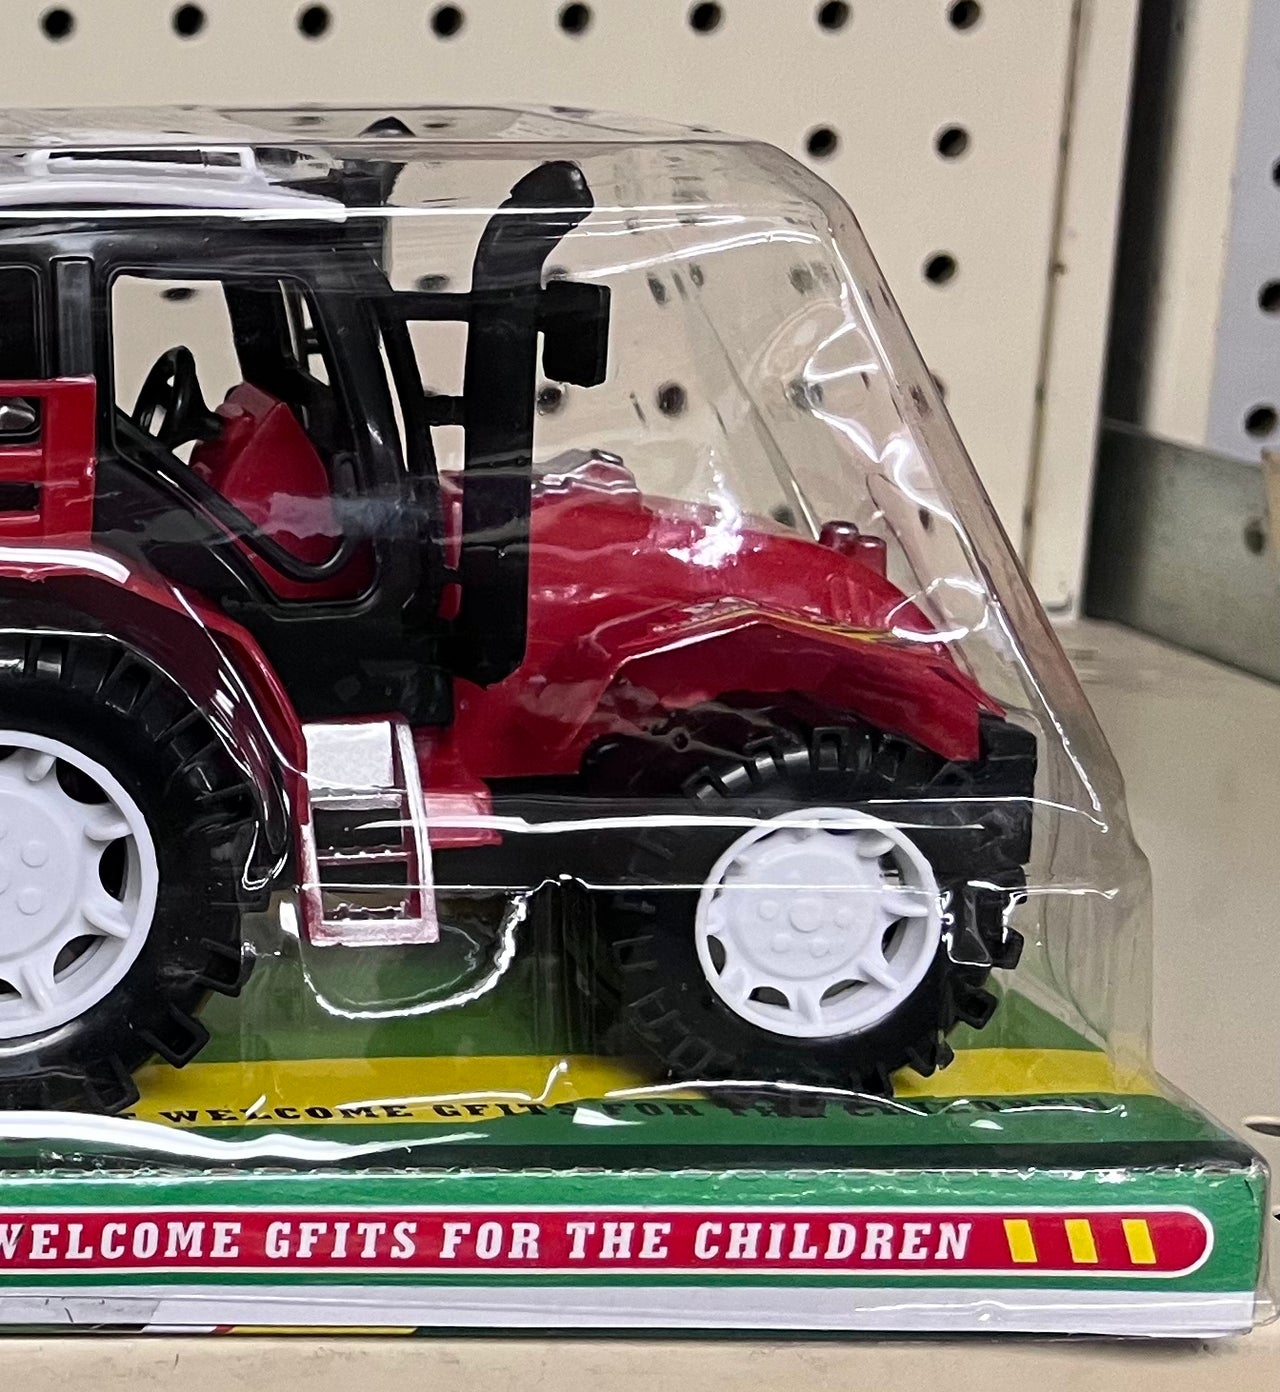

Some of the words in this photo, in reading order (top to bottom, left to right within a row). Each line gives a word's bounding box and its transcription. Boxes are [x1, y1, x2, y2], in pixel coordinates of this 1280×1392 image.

[159, 1105, 421, 1123] WELCOME
[265, 1222, 418, 1260] GFITS
[440, 1222, 541, 1260] FOR
[564, 1222, 673, 1261] THE
[693, 1222, 974, 1262] CHILDREN
